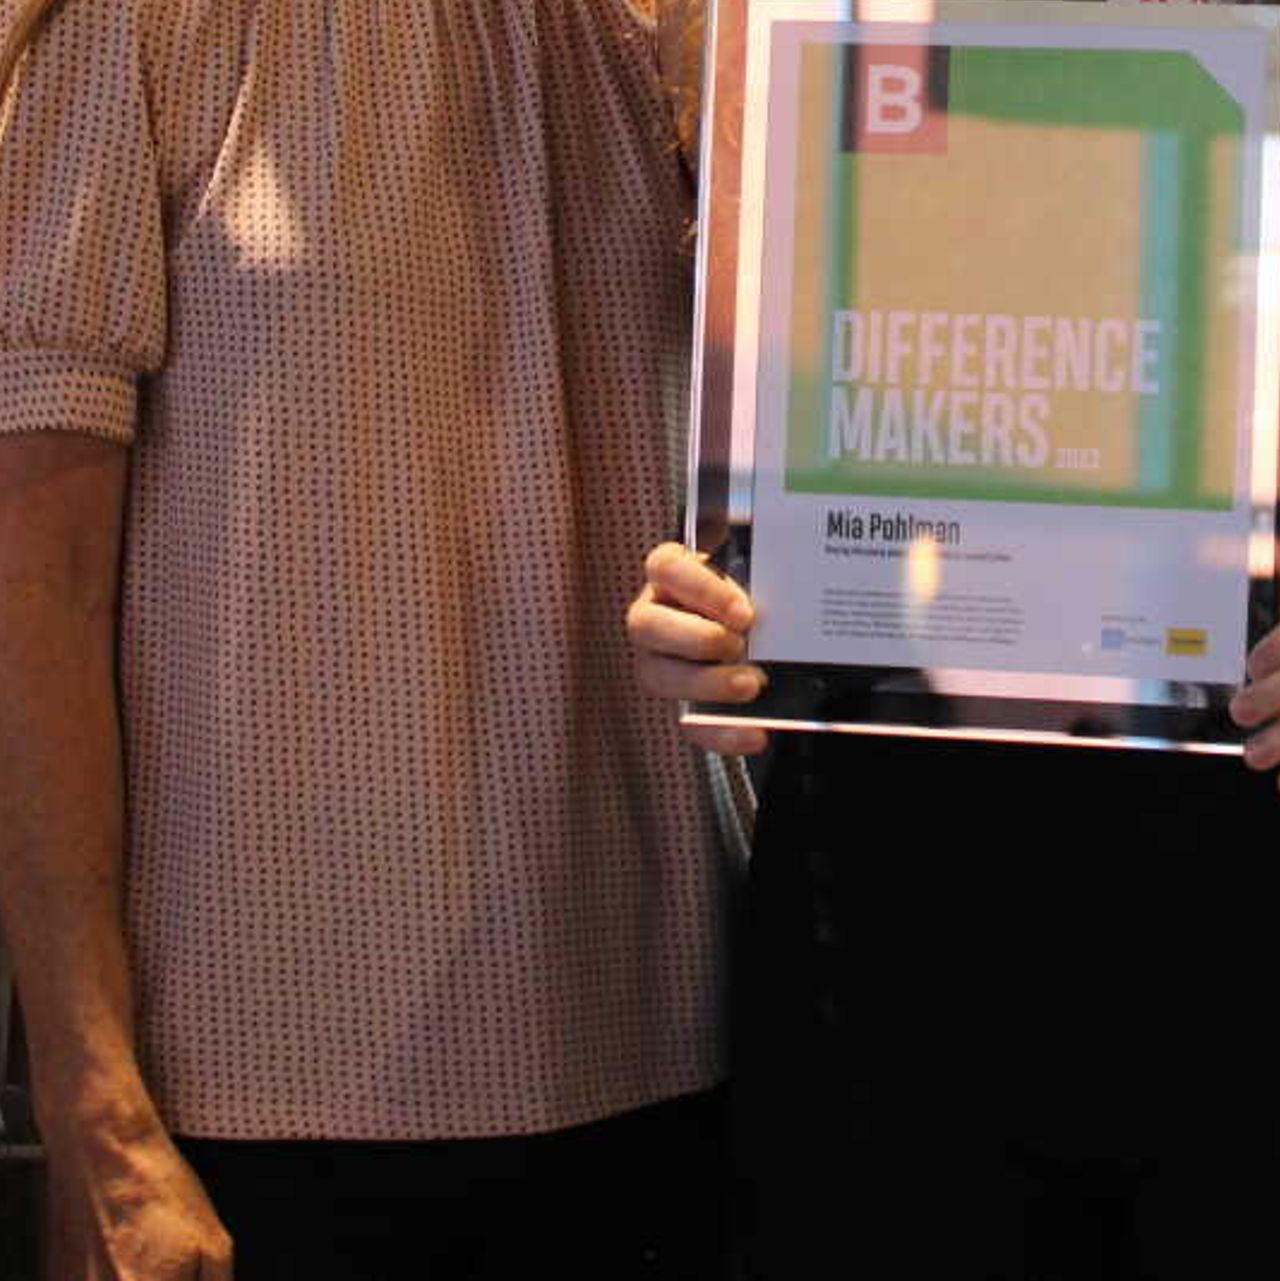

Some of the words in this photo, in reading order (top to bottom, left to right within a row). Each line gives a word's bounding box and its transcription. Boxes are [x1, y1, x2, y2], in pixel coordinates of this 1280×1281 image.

[867, 64, 923, 135] B
[830, 309, 1161, 395] DIFFERENCE
[827, 384, 1051, 469] MAKERS
[826, 509, 863, 541] Mia
[869, 511, 962, 545] Pohlman
